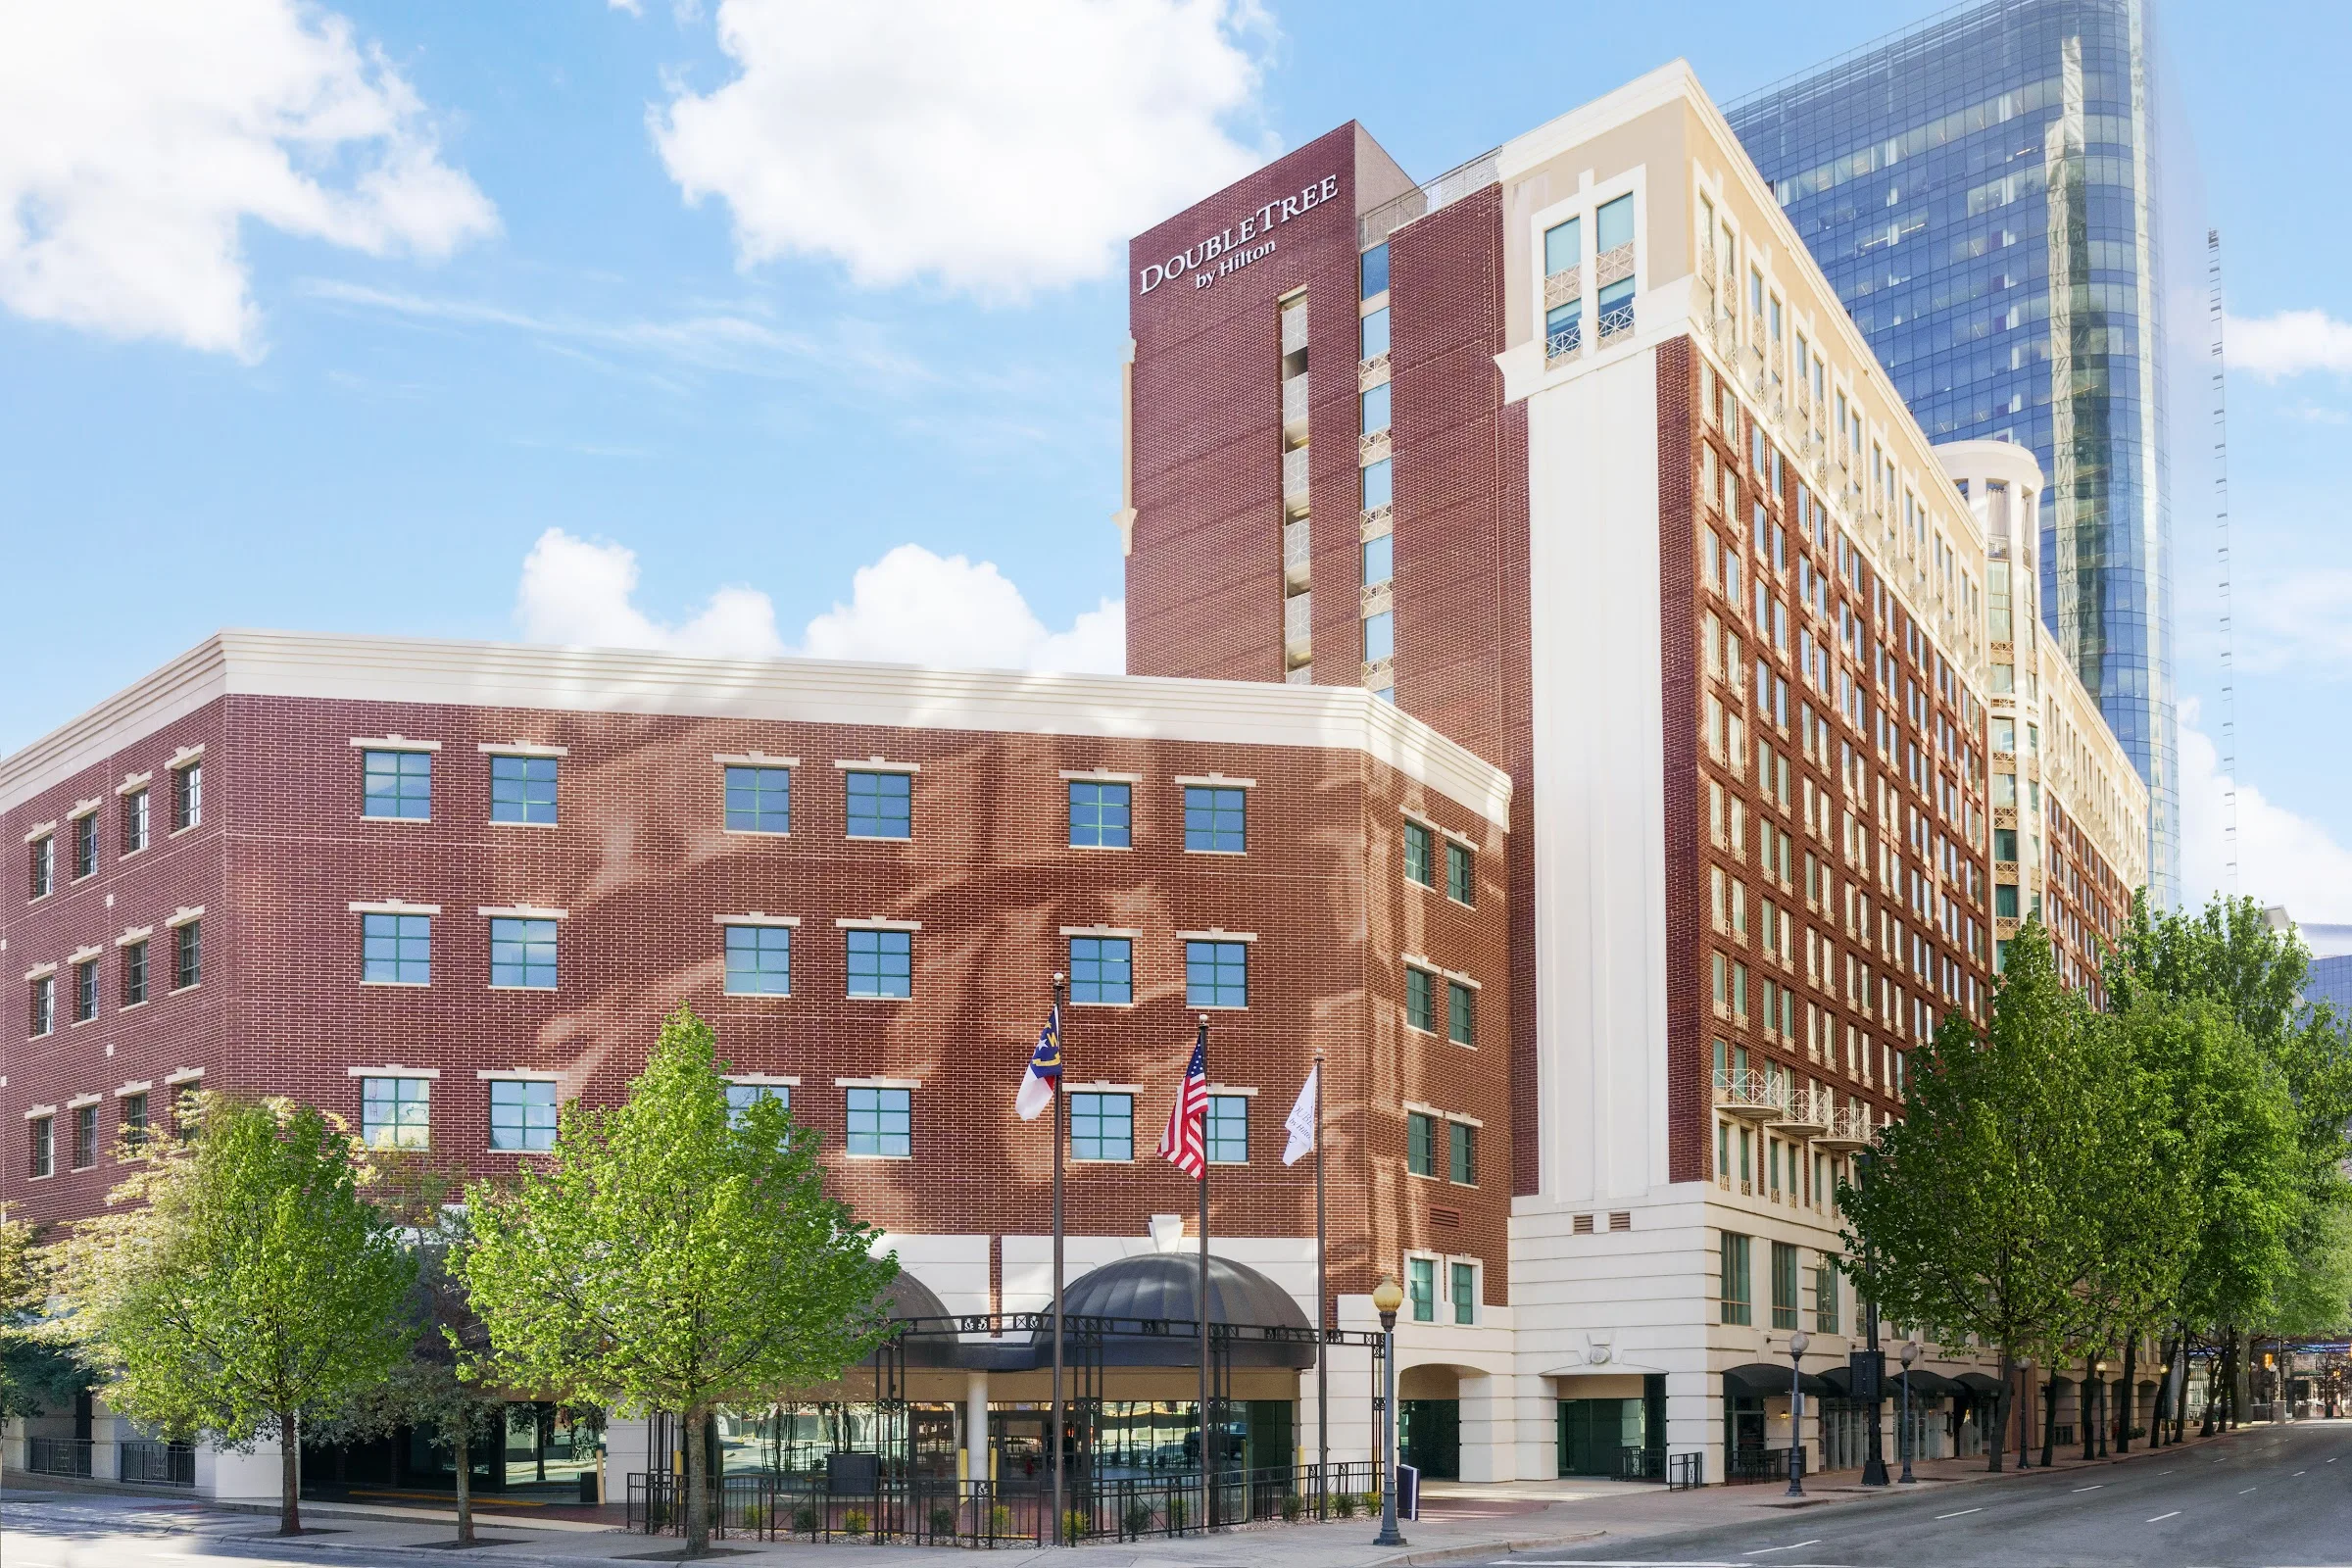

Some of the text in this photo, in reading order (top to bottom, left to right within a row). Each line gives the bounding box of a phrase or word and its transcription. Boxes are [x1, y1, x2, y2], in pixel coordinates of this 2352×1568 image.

[1140, 174, 1339, 295] DOUBLETREE
[1196, 240, 1276, 289] by Hilton
[1297, 1124, 1311, 1140] Hilto
